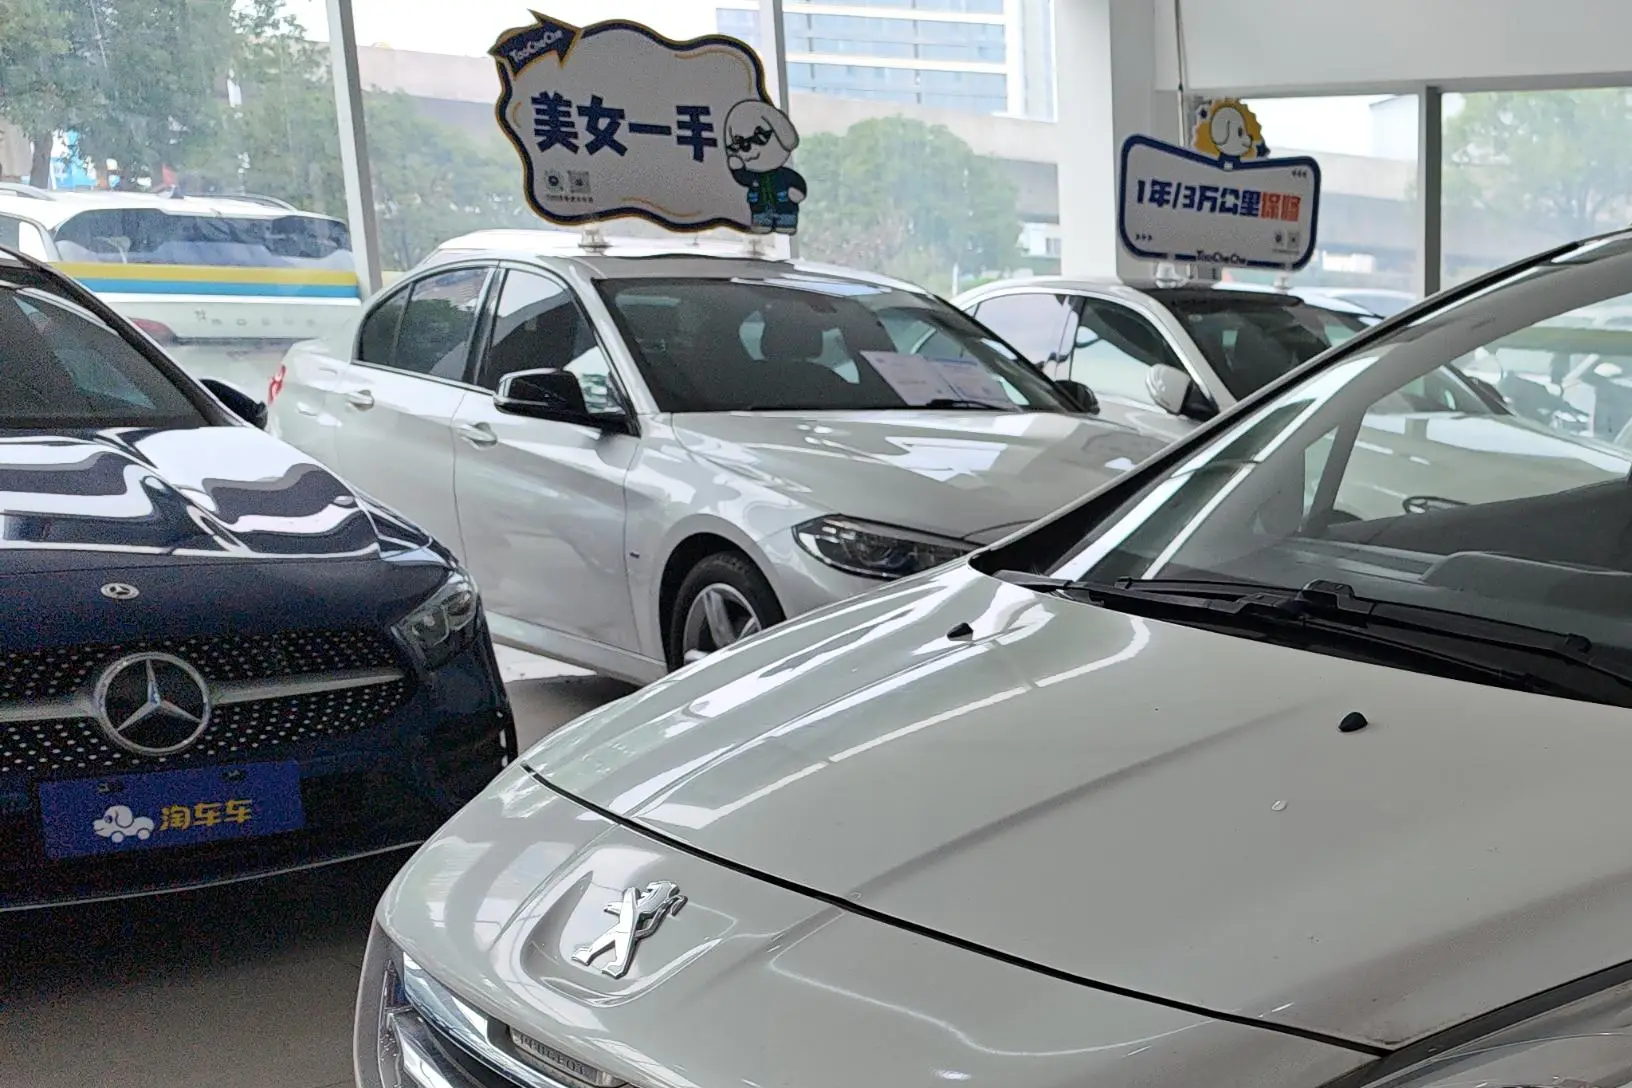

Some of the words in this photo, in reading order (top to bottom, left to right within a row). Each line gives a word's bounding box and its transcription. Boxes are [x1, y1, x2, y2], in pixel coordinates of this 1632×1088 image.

[530, 90, 718, 162] 美女一手
[160, 799, 253, 832] 淘车车
[519, 1033, 586, 1077] PEUGEOT
